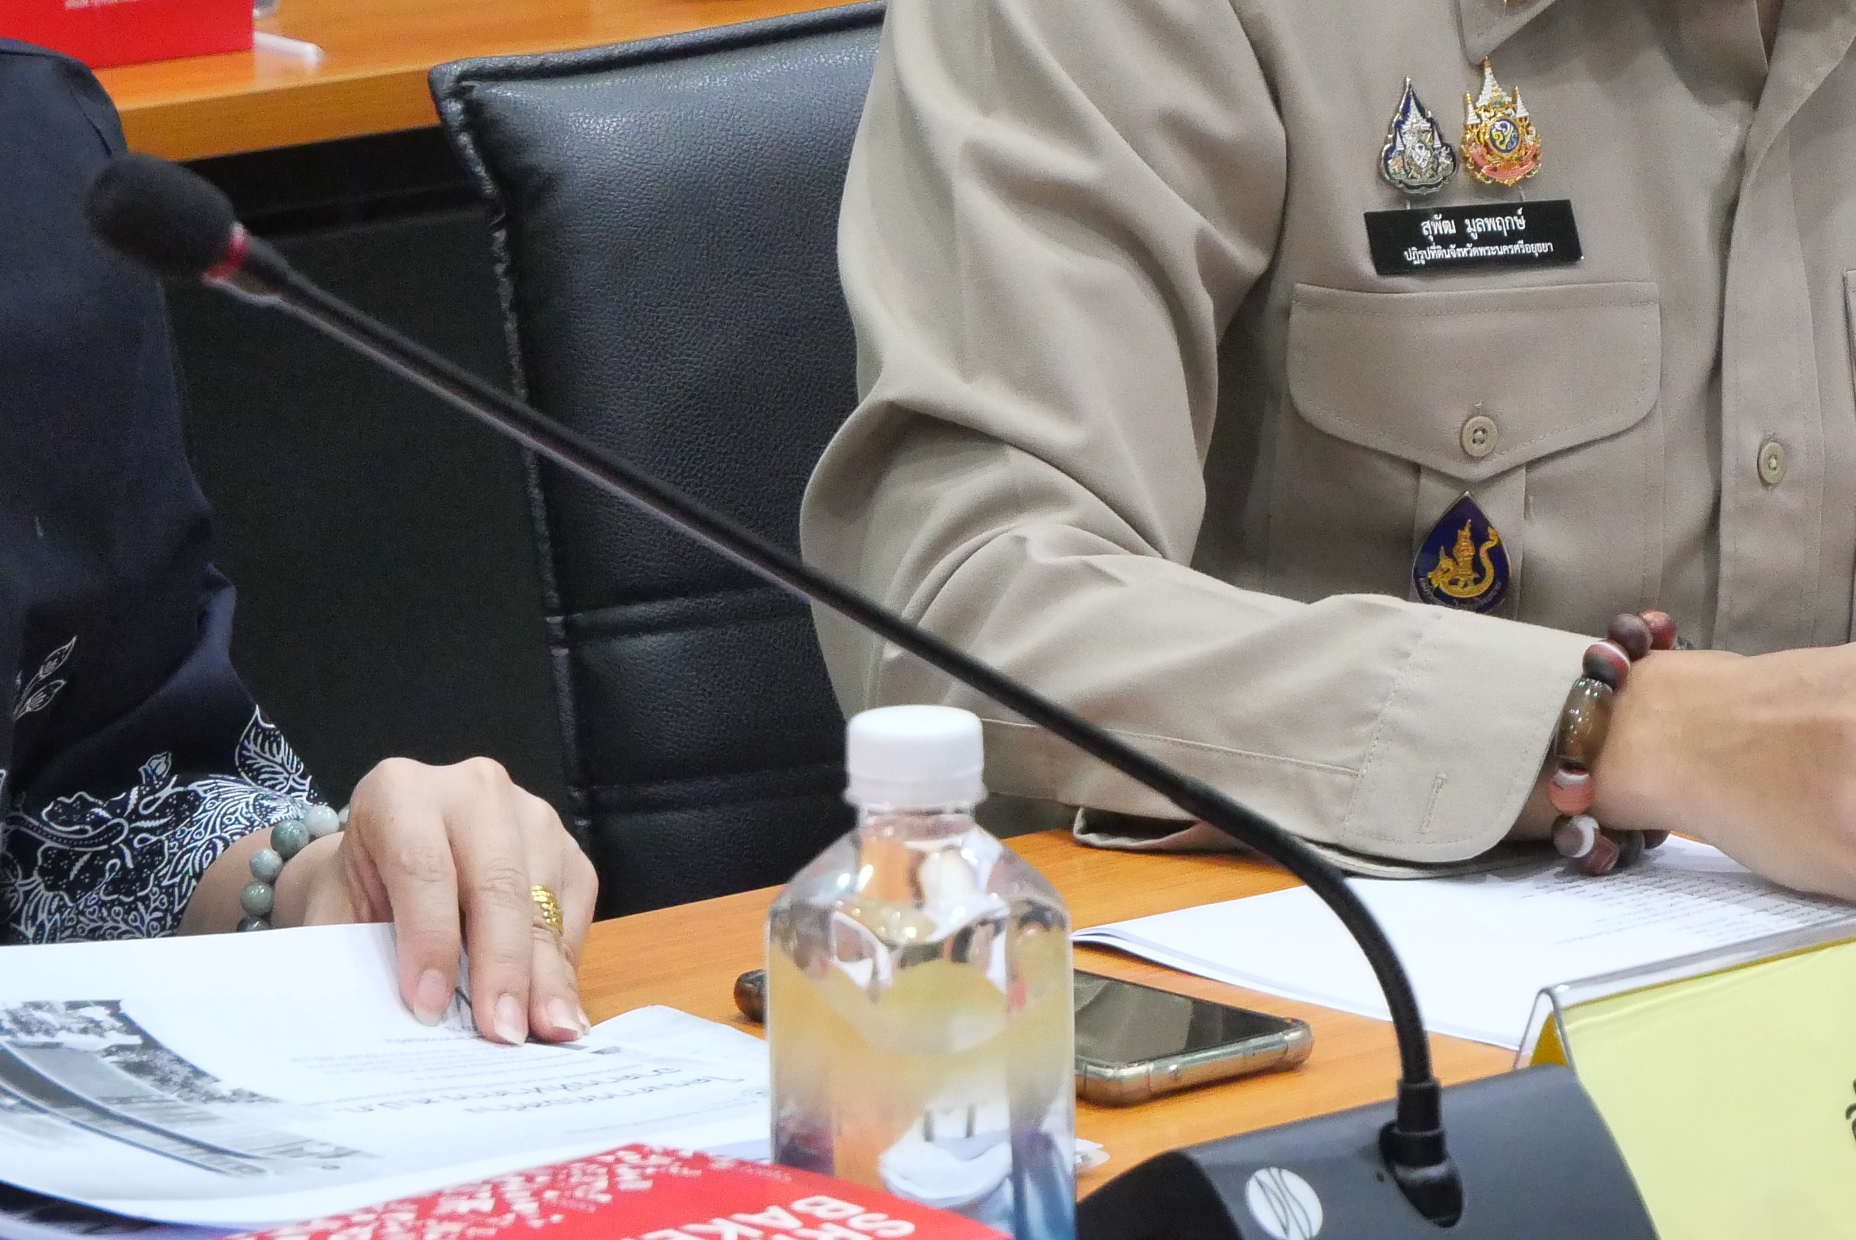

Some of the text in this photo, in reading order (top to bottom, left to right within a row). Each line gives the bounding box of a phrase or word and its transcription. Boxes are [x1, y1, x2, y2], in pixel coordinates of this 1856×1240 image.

[1464, 207, 1526, 240] มูลพฤกษ์
[1403, 240, 1554, 265] ปฏิรูปที่ดินจังหวัดพระนครศรีอยุธยา
